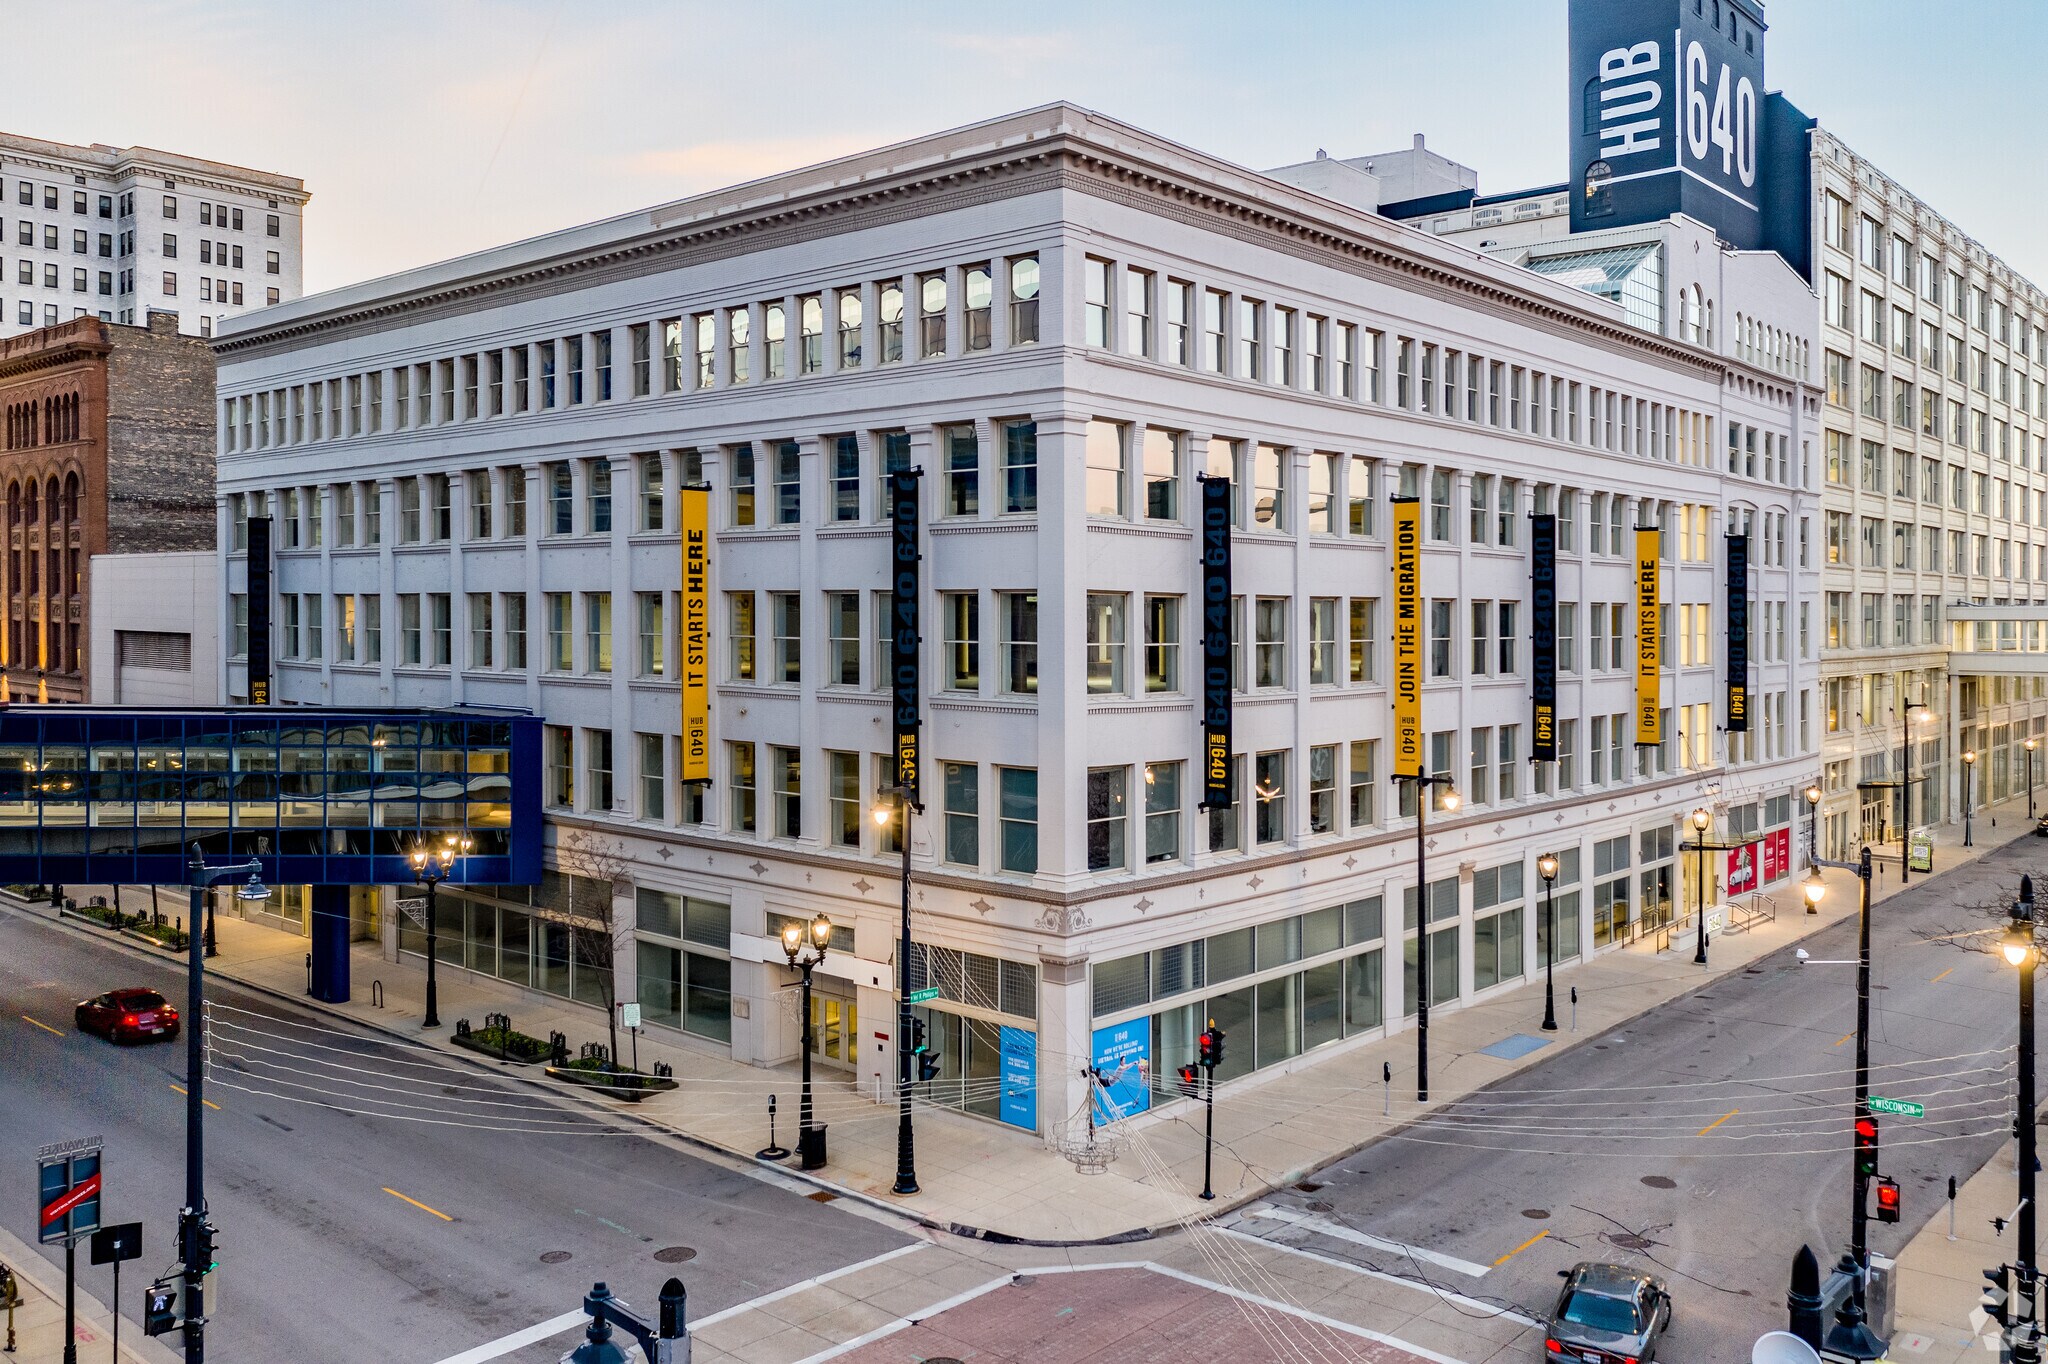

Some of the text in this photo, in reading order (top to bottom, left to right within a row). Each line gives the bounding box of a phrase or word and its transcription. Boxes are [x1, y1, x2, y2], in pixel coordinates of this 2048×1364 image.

[1600, 41, 1661, 158] HUB
[1687, 41, 1755, 187] 640
[688, 530, 703, 687] IT STARTS HERE
[897, 501, 917, 725] 640 640 640
[1205, 507, 1228, 726] 640 640 640
[1399, 520, 1415, 703] JOIN THE MIGRATION
[1535, 538, 1553, 699] 640 640 640
[1641, 560, 1655, 676] IT STARTS HERE
[255, 690, 266, 704] 64
[1733, 695, 1744, 714] 640
[1538, 716, 1551, 740] 640
[1643, 707, 1655, 726] 640
[691, 729, 704, 756] 640
[902, 734, 915, 744] HUB
[1211, 734, 1226, 744] HUB
[1402, 728, 1415, 754] 640
[1211, 748, 1226, 779] 640
[1875, 1099, 1915, 1114] WISCONSIN
